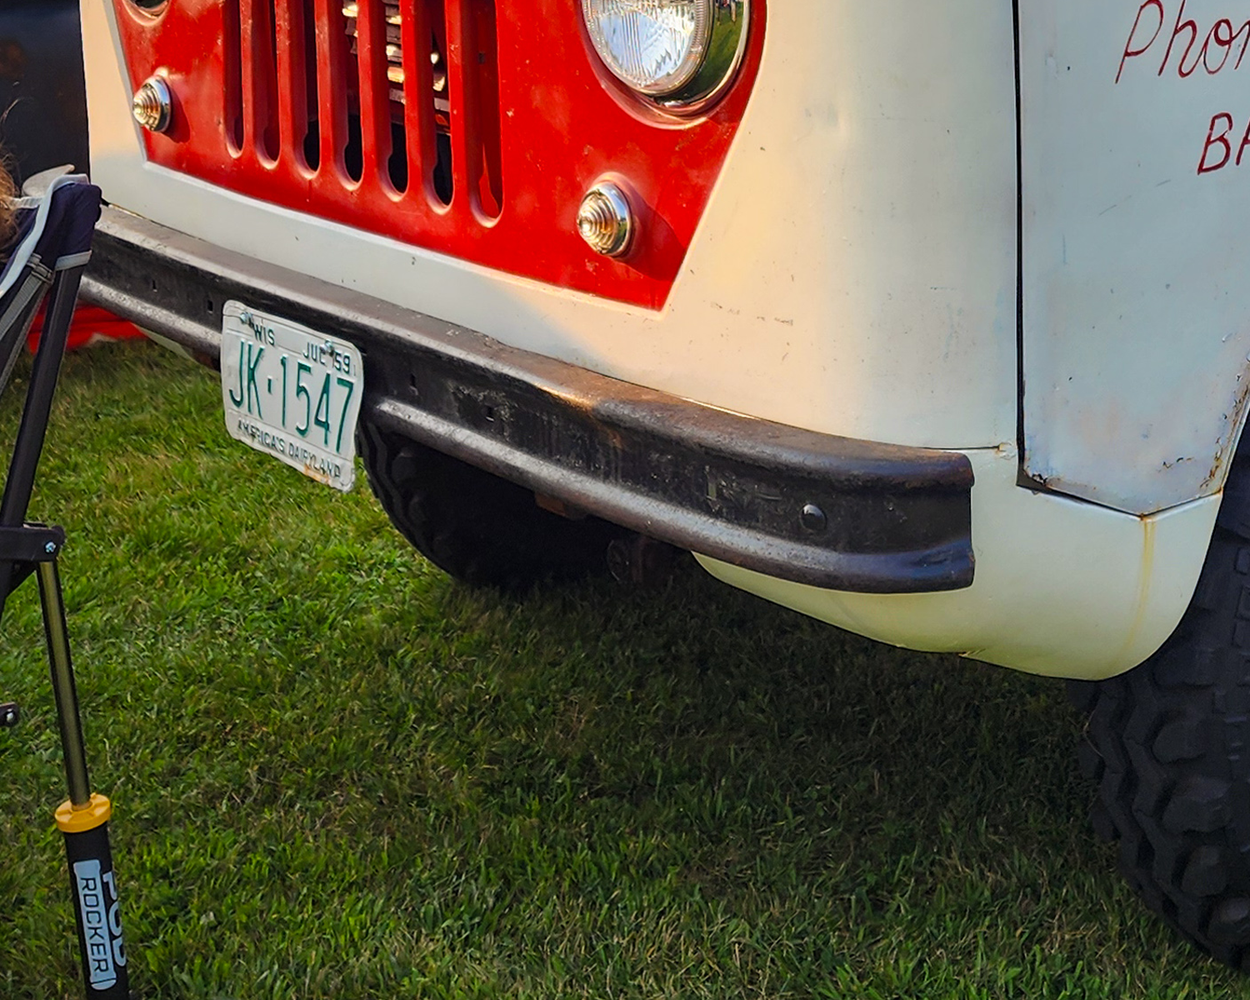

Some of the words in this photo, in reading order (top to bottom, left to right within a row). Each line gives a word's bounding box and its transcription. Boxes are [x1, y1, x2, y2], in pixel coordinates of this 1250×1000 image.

[252, 323, 276, 346] WIS
[237, 418, 286, 454] AMERICA'S
[288, 442, 341, 479] DAIRYLAND
[80, 877, 109, 973] ROCKER
